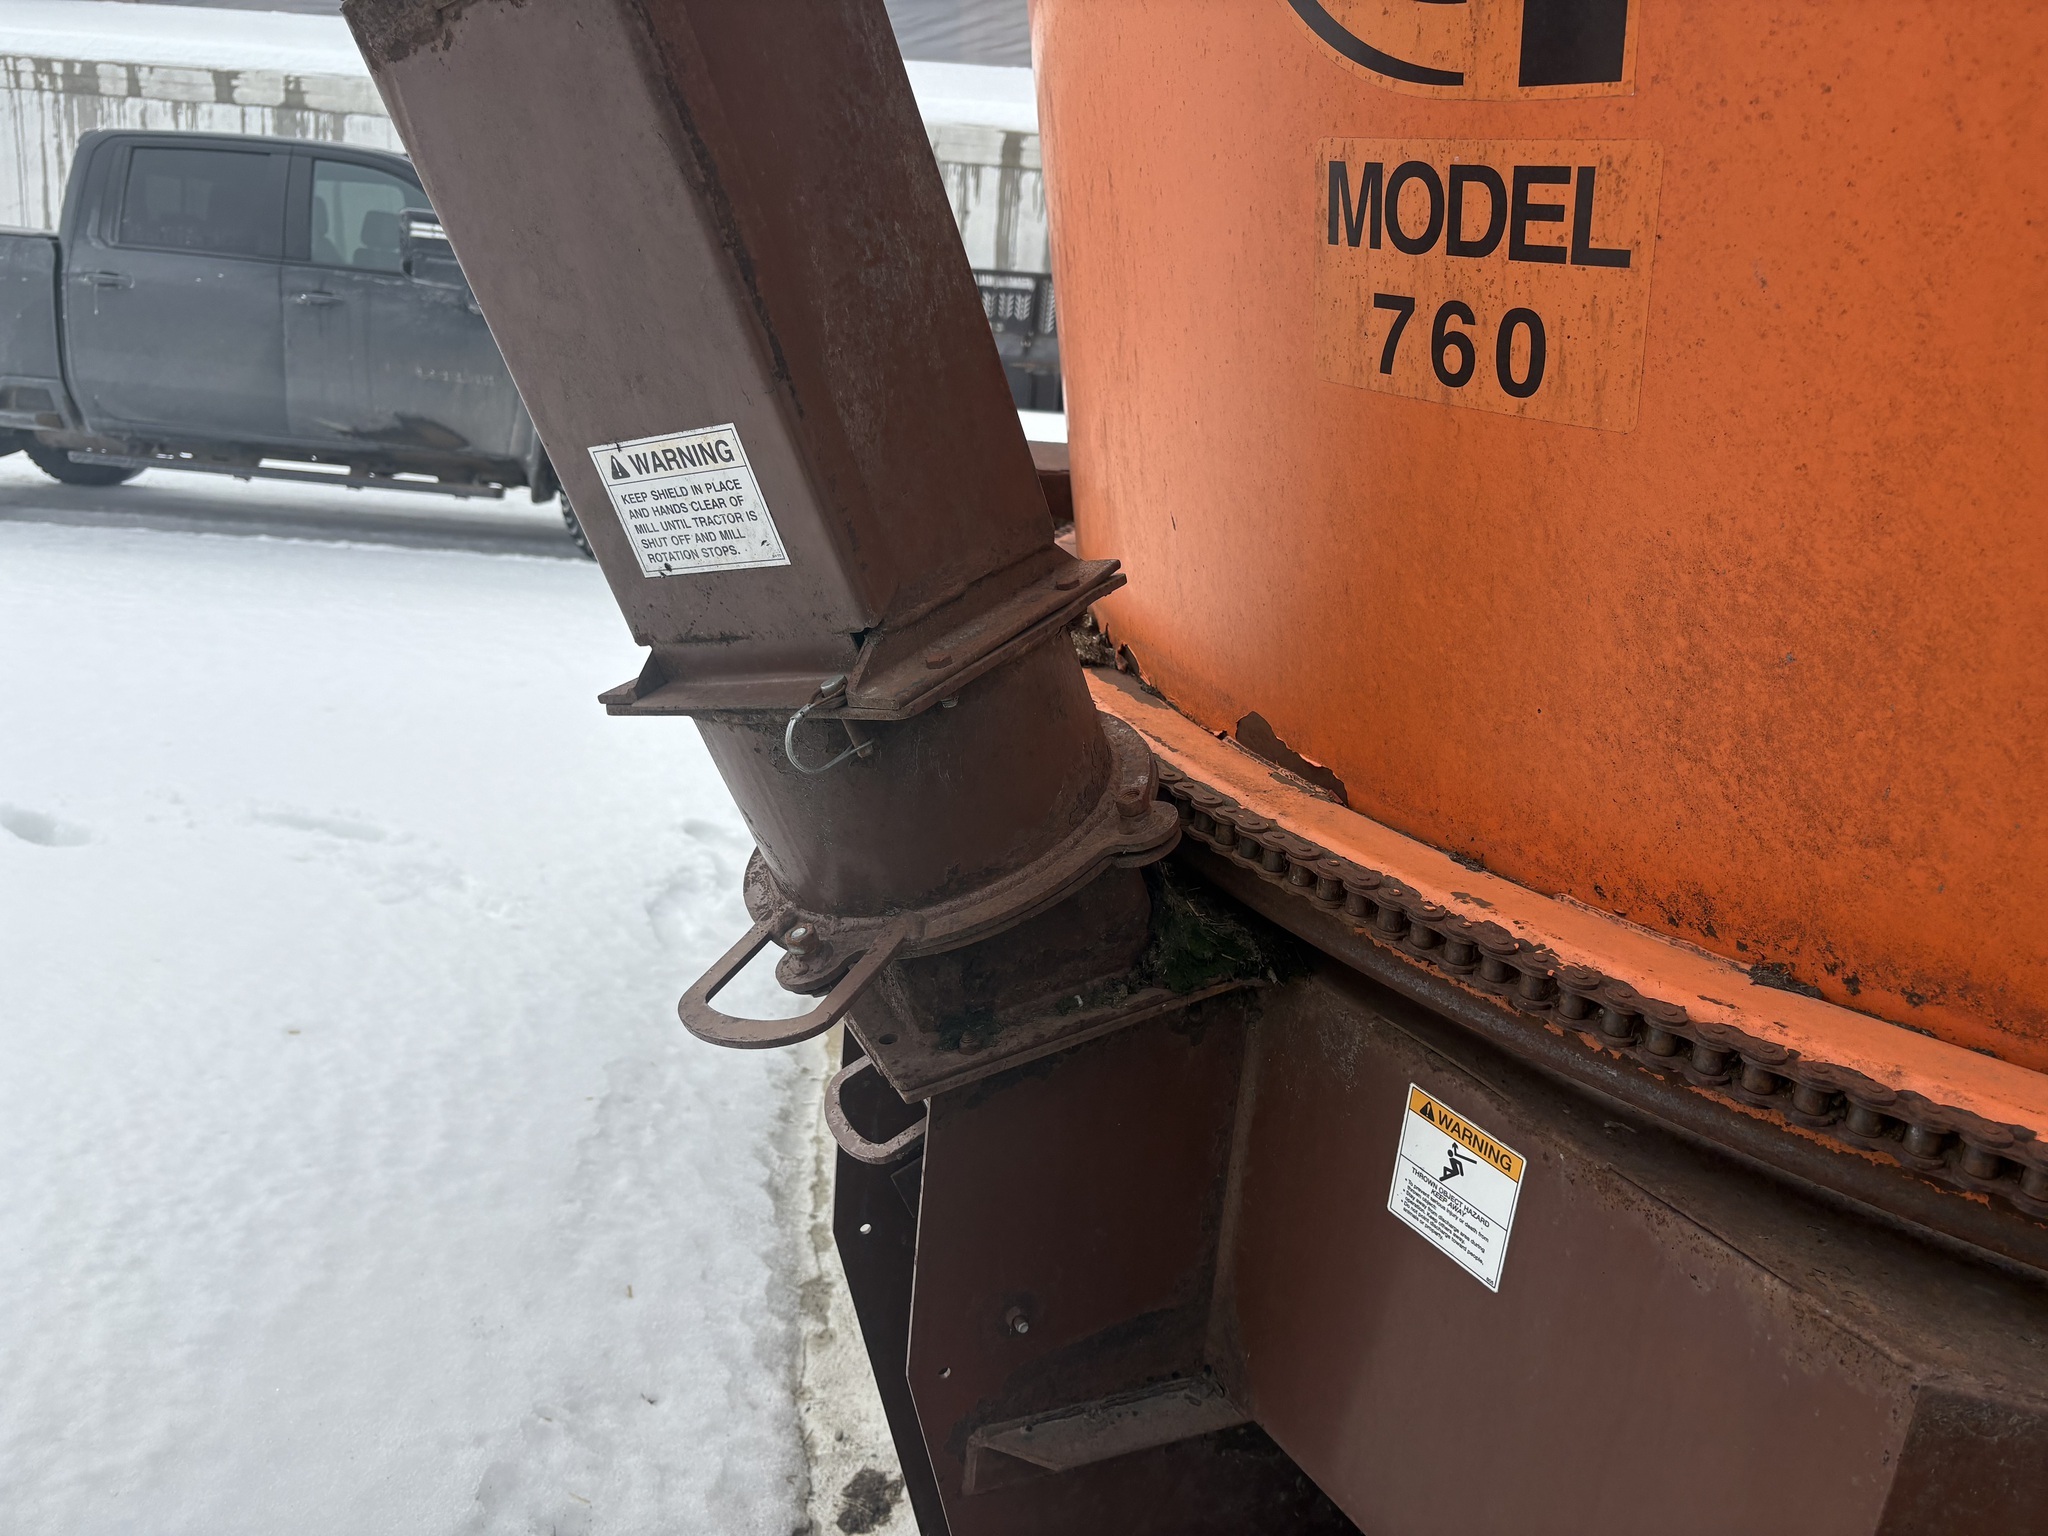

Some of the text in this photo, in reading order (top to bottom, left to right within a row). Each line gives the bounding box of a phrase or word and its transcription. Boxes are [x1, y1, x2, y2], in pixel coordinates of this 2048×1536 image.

[1327, 160, 1631, 269] MODEL
[1373, 292, 1546, 399] 760
[627, 439, 735, 476] WARNING
[620, 479, 742, 504] KEEP SHIELD IN PLACE
[627, 495, 745, 519] AND HANDS CLEAR OF
[634, 510, 758, 534] MILL UNTIL TRACTOR IS
[640, 528, 745, 548] SHUT OFF AND MILL
[647, 545, 740, 562] ROTATION STOPS.
[1437, 1110, 1512, 1172] WARNING
[1412, 1167, 1489, 1227] THROWN OBJECT HAZARD
[1431, 1188, 1466, 1218] KEEP AWAY
